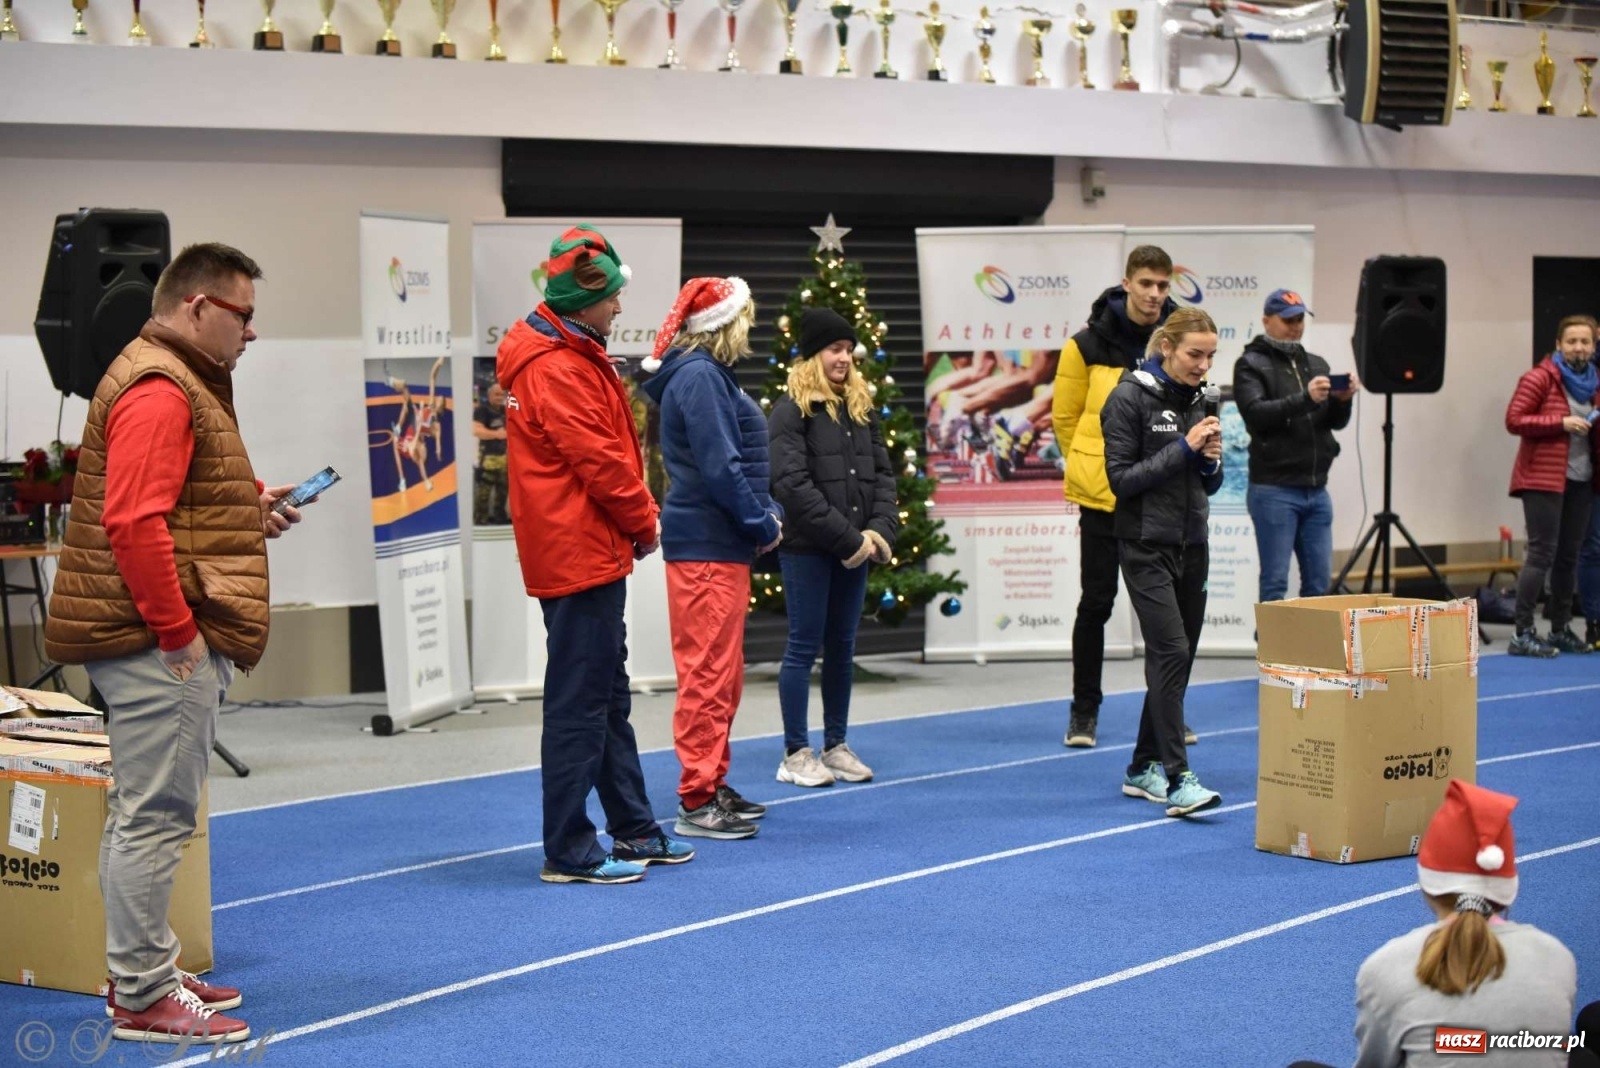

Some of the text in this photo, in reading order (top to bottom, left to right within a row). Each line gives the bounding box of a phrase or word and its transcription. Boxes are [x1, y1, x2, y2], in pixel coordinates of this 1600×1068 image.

[1018, 276, 1070, 290] ZSOMS
[1206, 276, 1258, 290] ZSOMS
[377, 324, 451, 350] Wrestling
[938, 321, 1088, 341] Athleti
[1152, 424, 1178, 432] ORLEN
[964, 523, 1081, 538] smsraciborz.p
